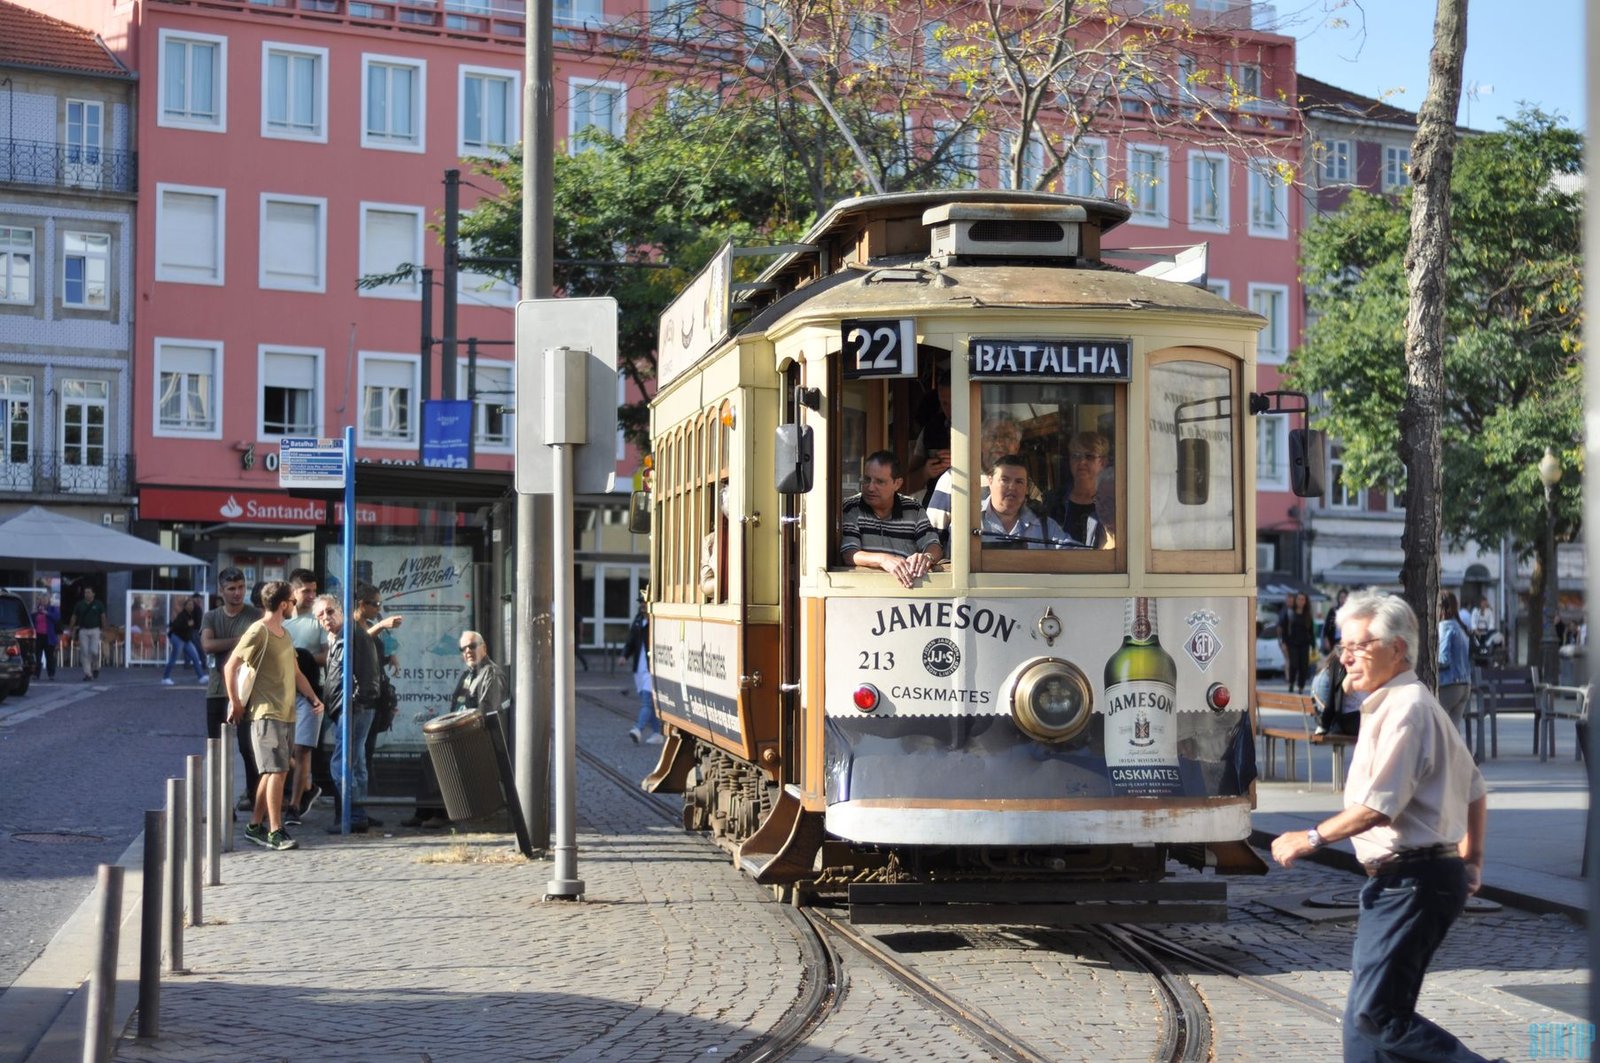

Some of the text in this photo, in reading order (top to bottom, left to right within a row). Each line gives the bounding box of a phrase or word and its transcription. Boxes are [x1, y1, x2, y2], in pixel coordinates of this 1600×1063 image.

[847, 327, 898, 370] 22
[975, 345, 1121, 373] BATALHA
[247, 500, 326, 520] Santande
[398, 555, 442, 575] A VODKA
[379, 574, 408, 593] PARA
[871, 602, 1017, 643] JAMESON
[858, 651, 895, 670] 213
[891, 686, 990, 704] CASKMATES
[1108, 692, 1174, 716] JAMESON
[1112, 769, 1179, 780] CASKMATES
